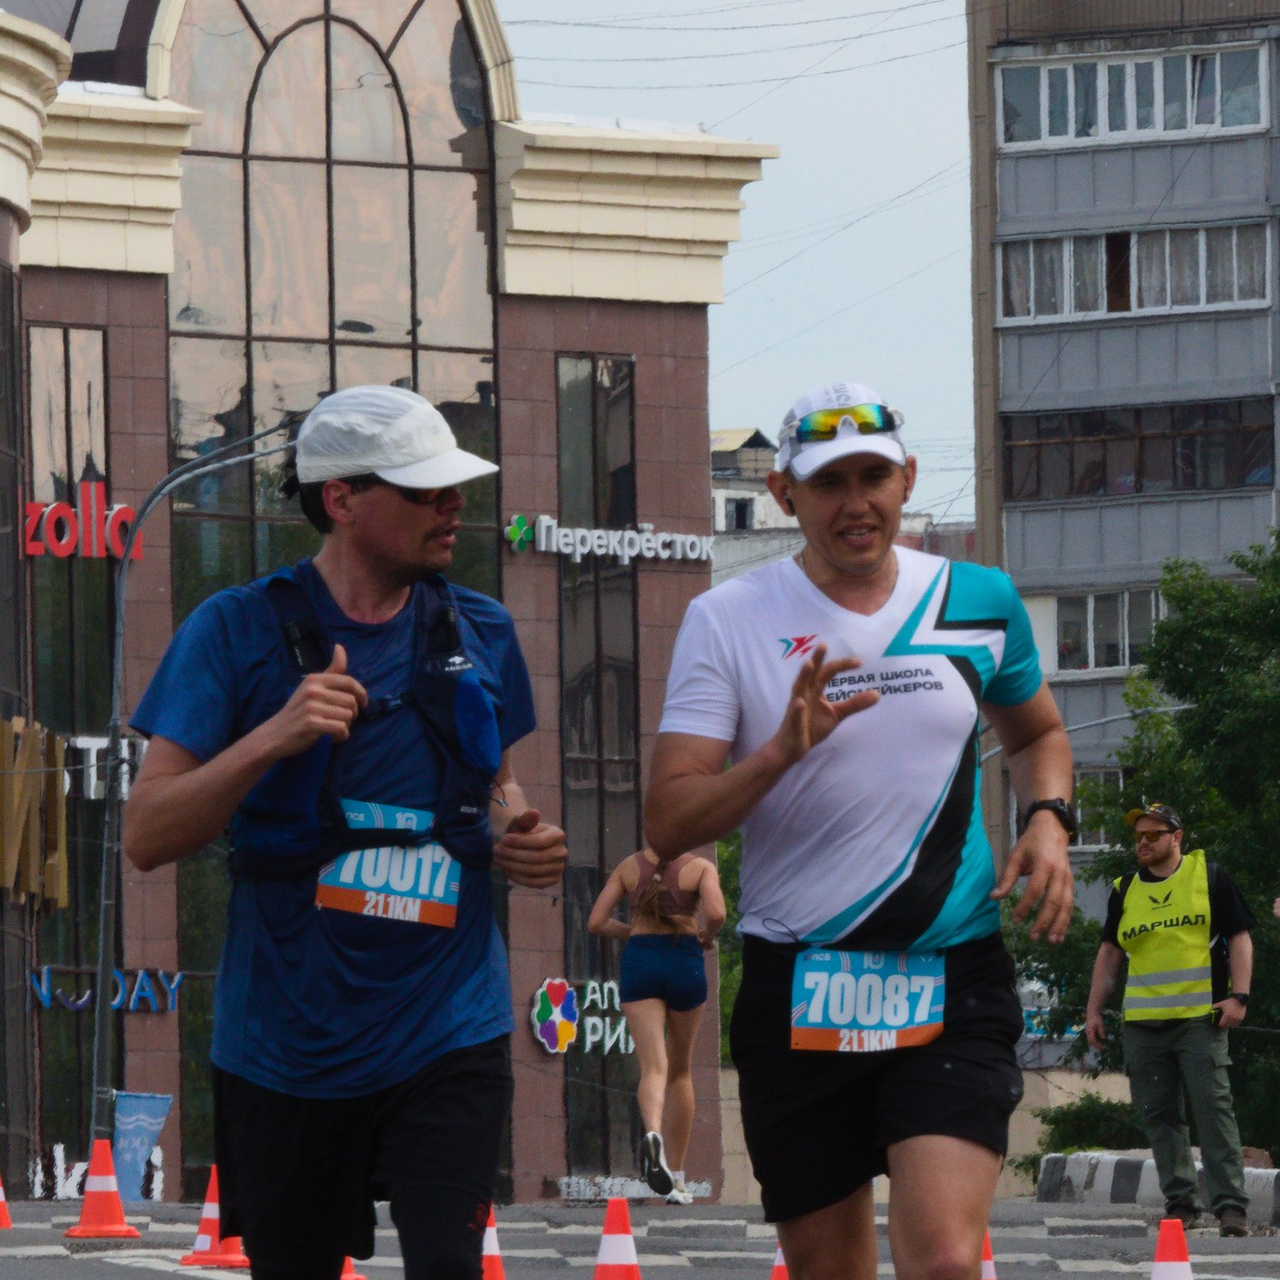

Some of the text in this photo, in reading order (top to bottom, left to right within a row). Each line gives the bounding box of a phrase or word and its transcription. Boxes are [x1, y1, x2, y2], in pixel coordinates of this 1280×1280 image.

[535, 515, 715, 565] Перекрёсток
[880, 668, 934, 682] ШКОЛА
[339, 843, 452, 898] 70017
[1121, 914, 1206, 942] МАРШАЛ
[804, 971, 935, 1027] 70087
